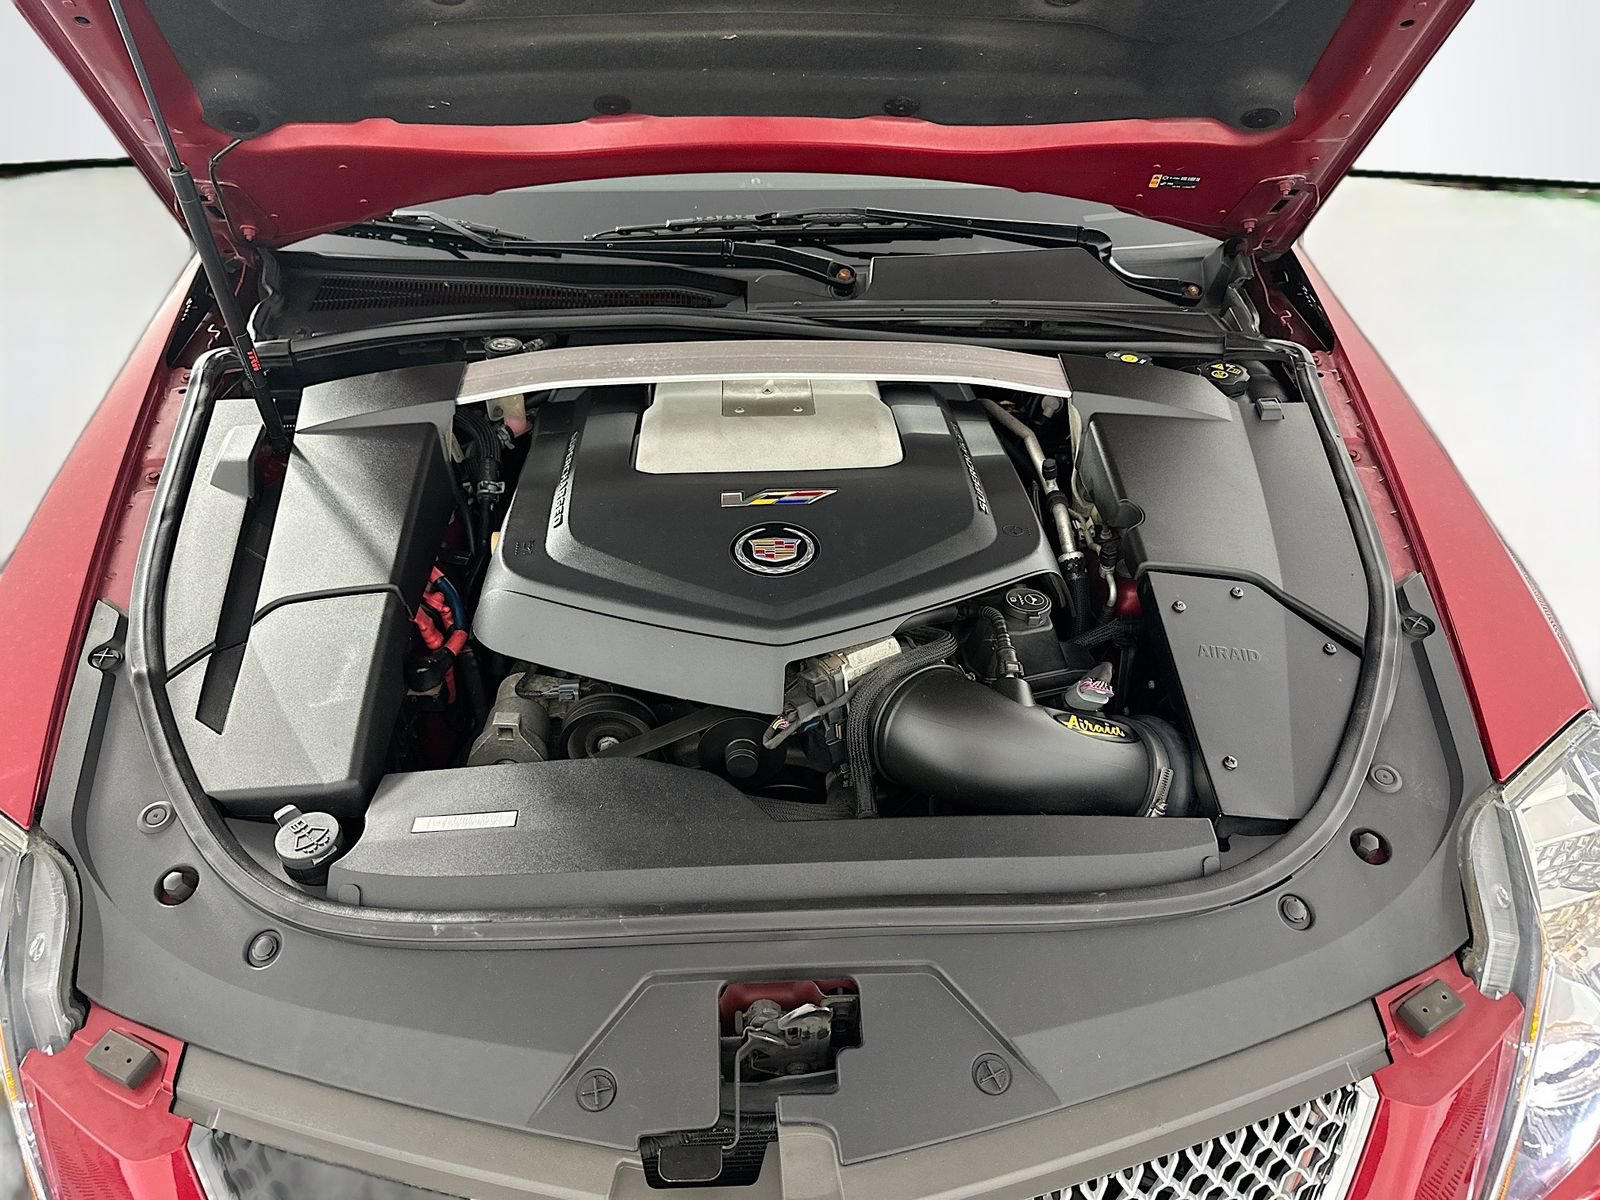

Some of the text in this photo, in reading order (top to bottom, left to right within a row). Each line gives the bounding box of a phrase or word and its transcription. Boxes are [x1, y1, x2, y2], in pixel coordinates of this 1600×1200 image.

[553, 431, 578, 529] SUPERCHARGED
[951, 421, 989, 515] SUPERCH
[1197, 643, 1262, 662] AIRAID
[1066, 714, 1126, 738] Airaid
